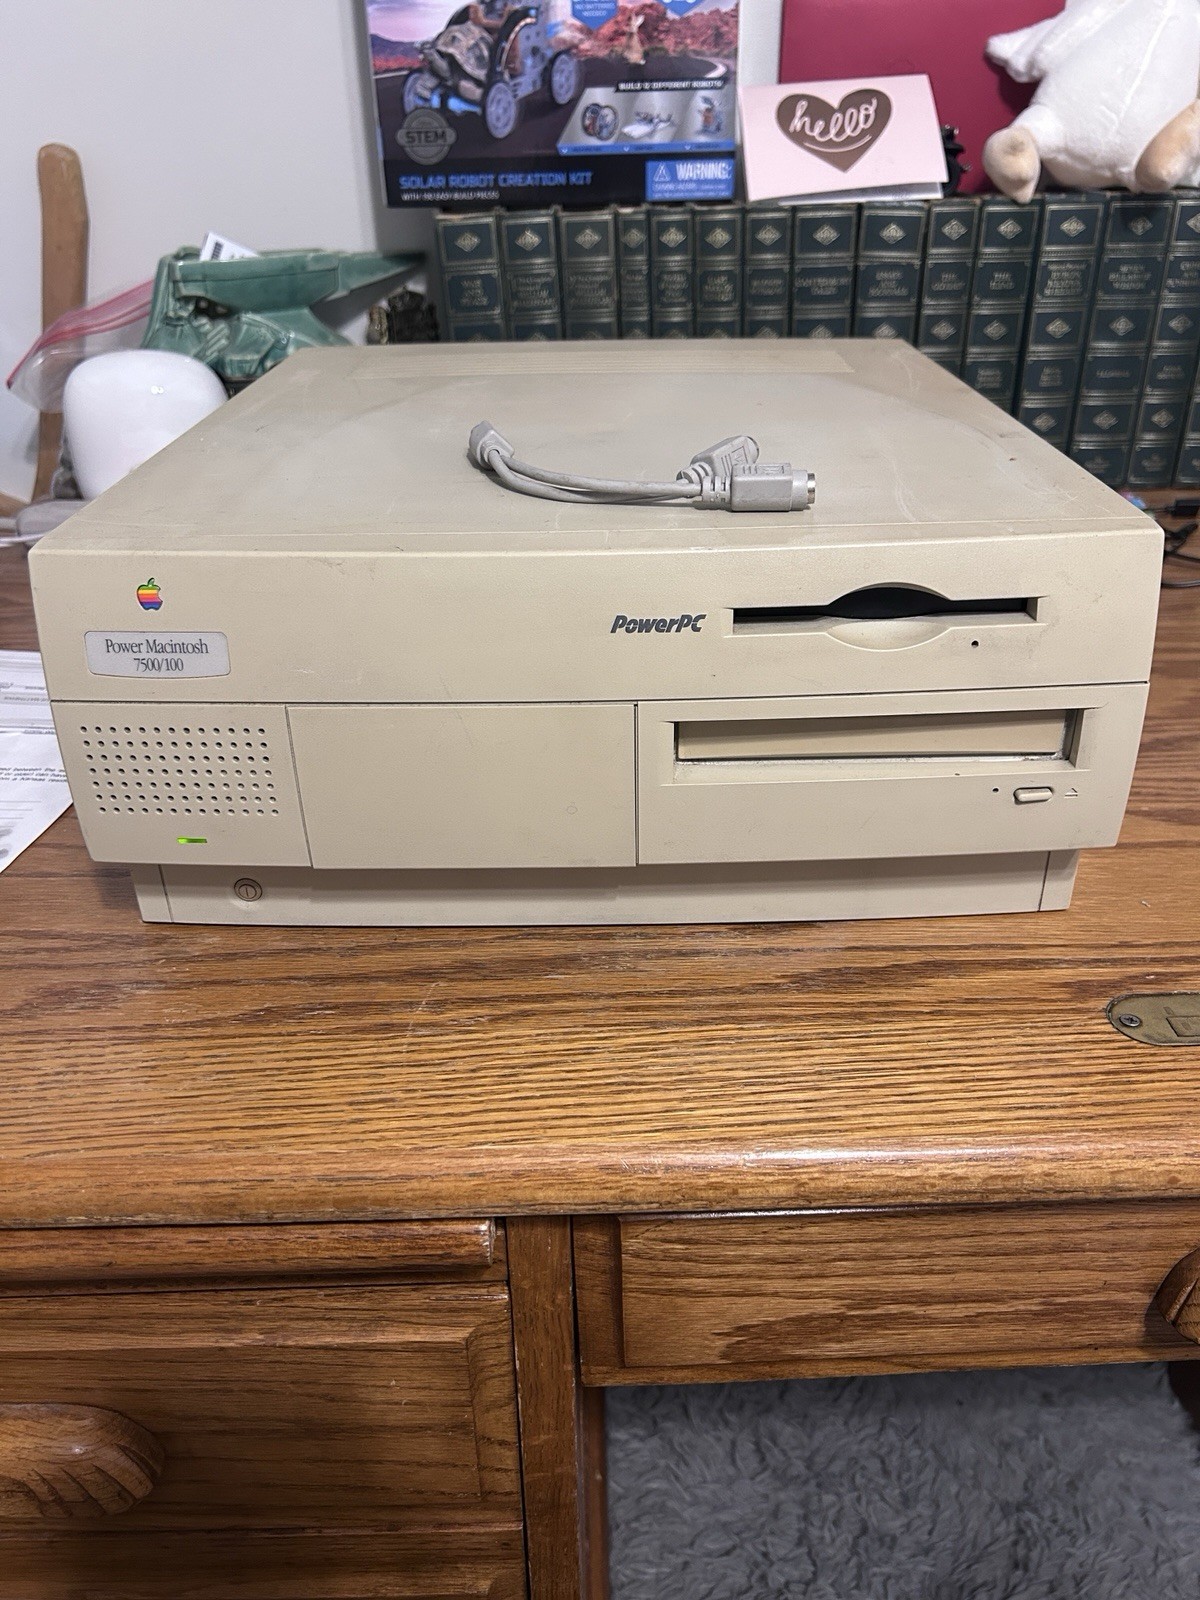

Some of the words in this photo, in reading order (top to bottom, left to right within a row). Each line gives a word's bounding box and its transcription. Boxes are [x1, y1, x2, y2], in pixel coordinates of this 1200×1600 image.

[789, 96, 878, 143] hello
[406, 130, 447, 144] STEM
[399, 174, 446, 189] SOLAR
[448, 173, 495, 188] ROBOT
[497, 171, 567, 187] CREATION
[569, 170, 592, 186] KIT
[401, 192, 419, 201] WITH
[610, 613, 707, 633] PowerPC
[105, 638, 143, 654] Power
[146, 638, 209, 654] Macintosh
[133, 657, 184, 673] 7500/100
